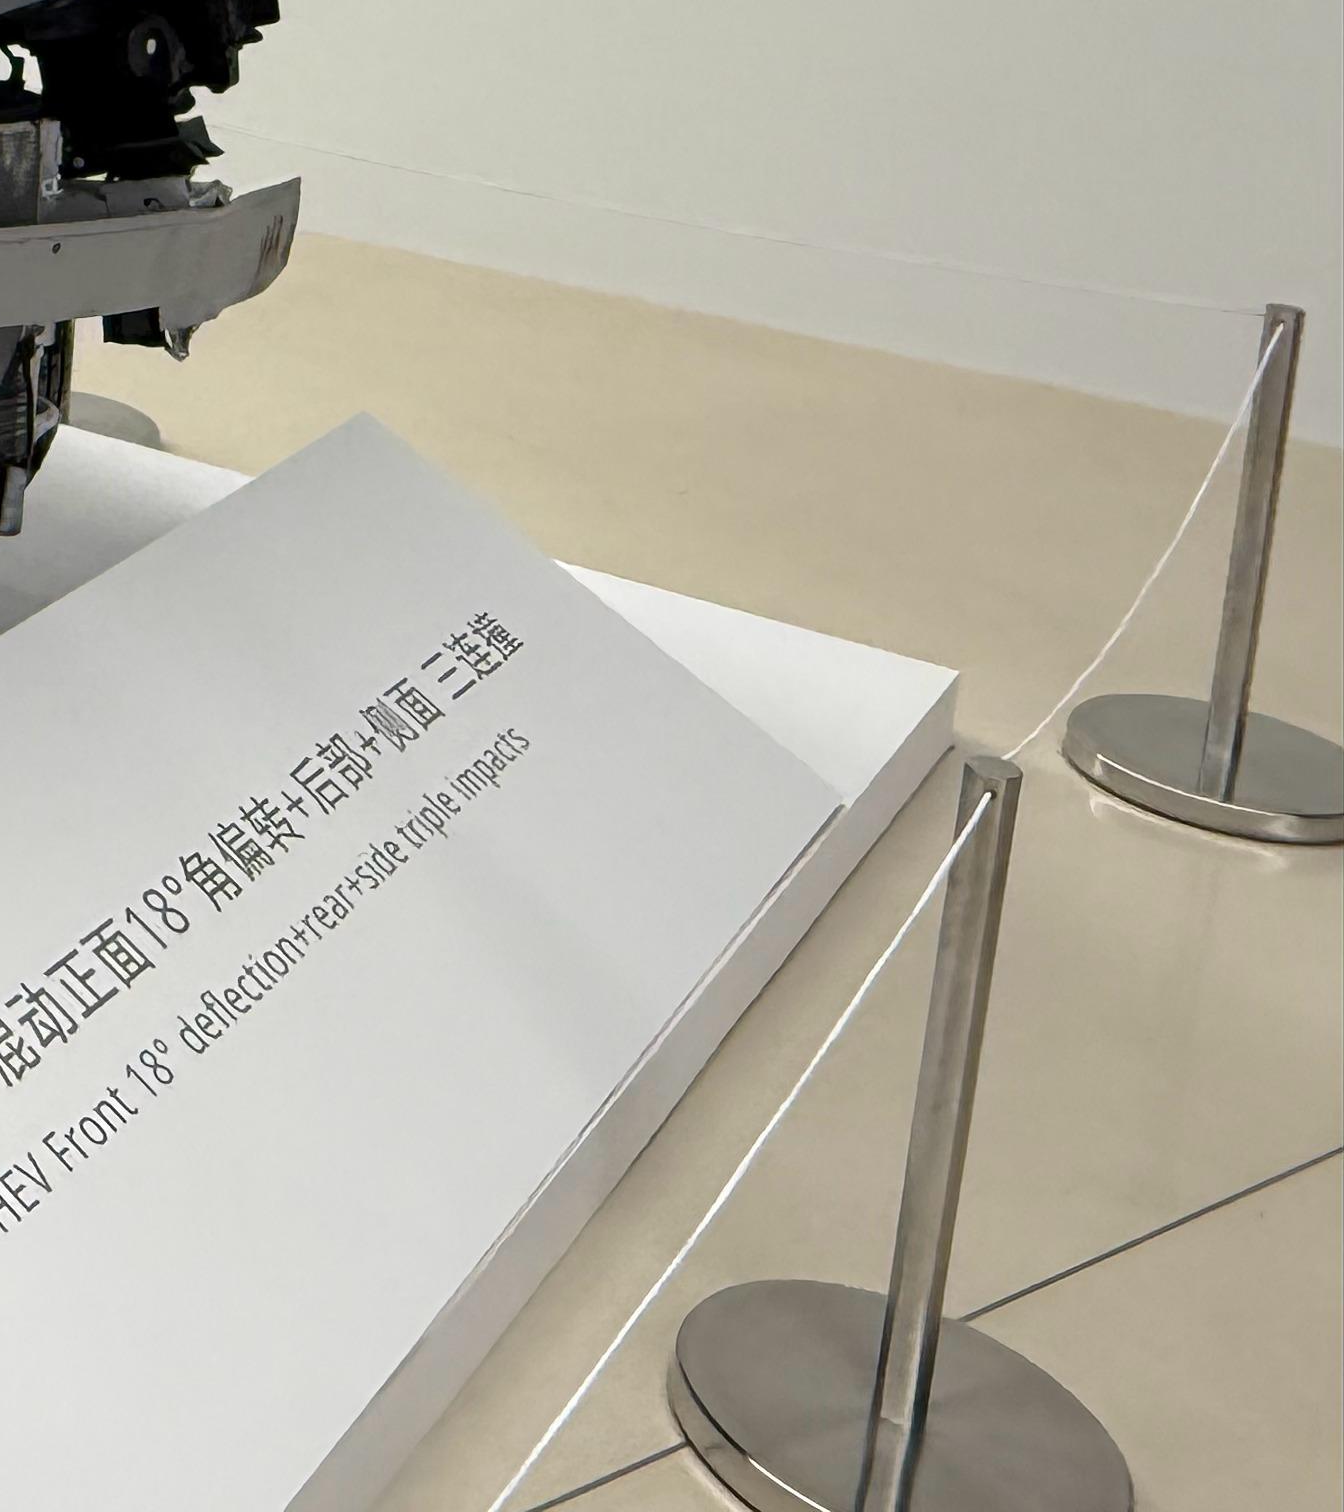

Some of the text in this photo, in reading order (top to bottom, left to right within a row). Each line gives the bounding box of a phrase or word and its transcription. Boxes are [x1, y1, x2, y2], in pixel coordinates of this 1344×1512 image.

[42, 1085, 139, 1173] Front
[178, 836, 409, 1055] deflection+rear+side
[395, 782, 462, 849] triple
[445, 727, 531, 802] impacts
